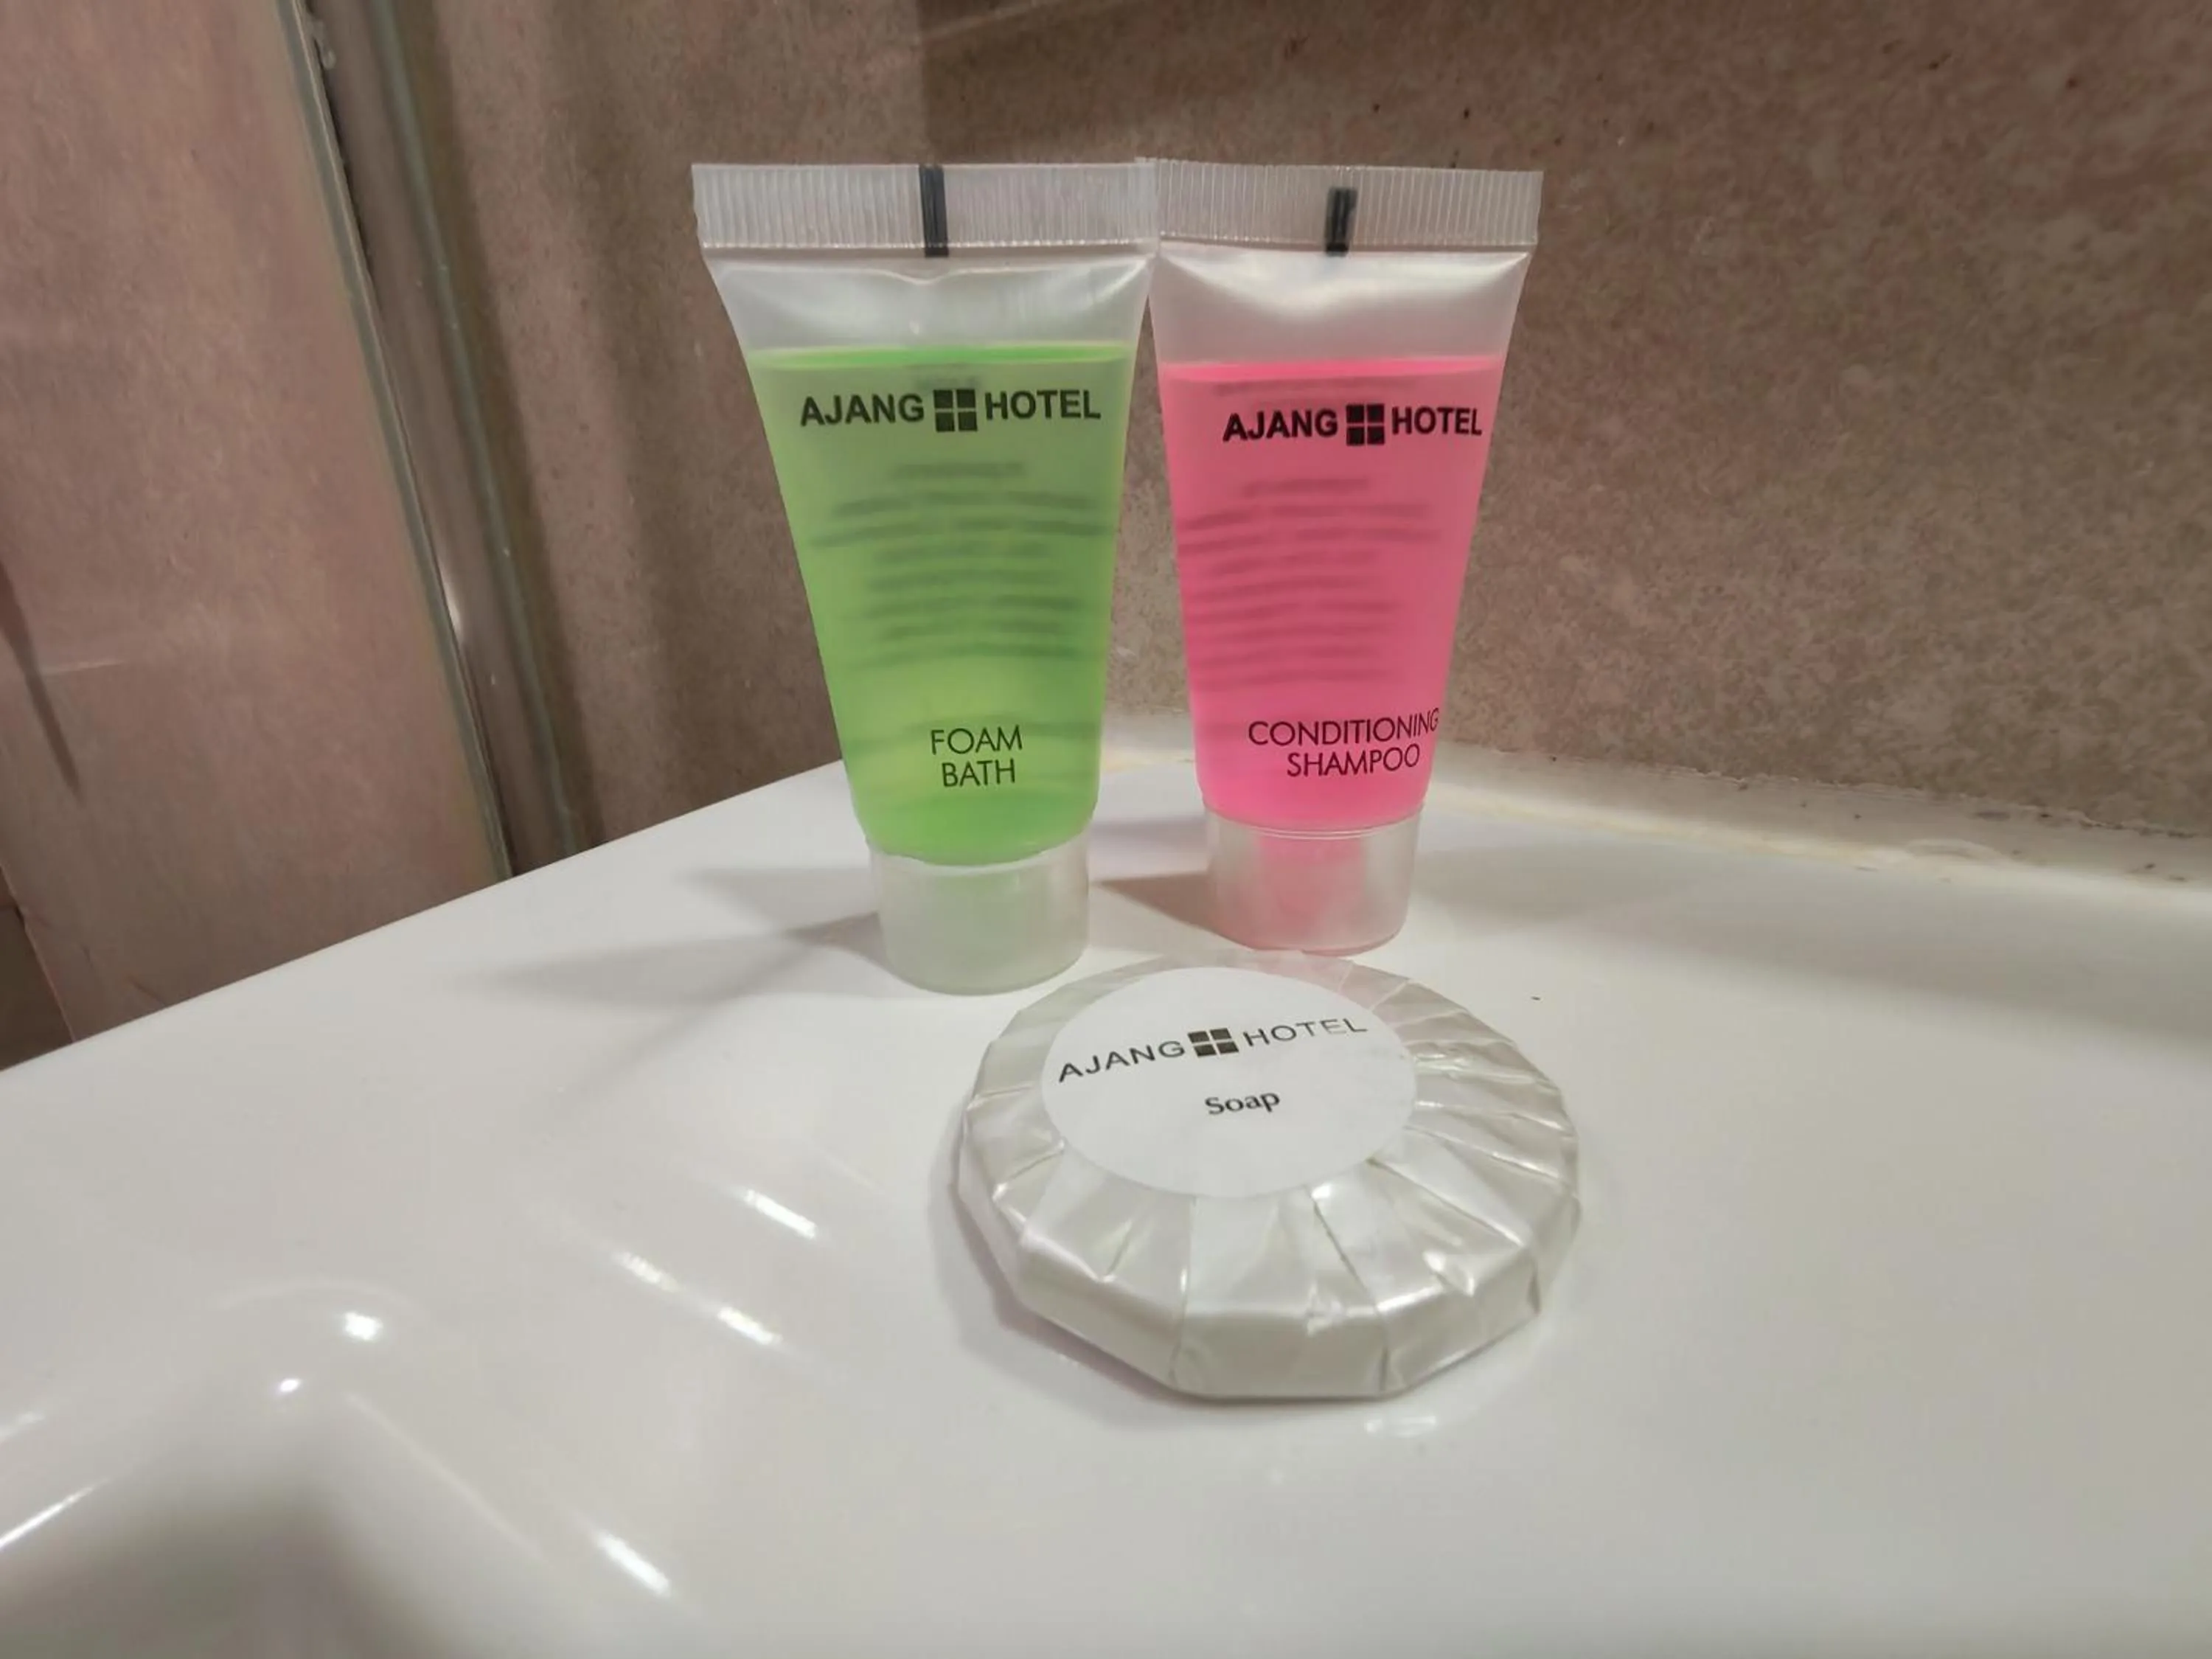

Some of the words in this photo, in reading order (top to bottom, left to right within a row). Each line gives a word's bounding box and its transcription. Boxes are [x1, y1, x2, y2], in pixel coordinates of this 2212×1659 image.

[800, 393, 925, 426] AJANG
[984, 389, 1102, 420] HOTEL
[1222, 408, 1339, 442] AJANG
[1391, 406, 1483, 436] HOTEL
[930, 725, 1023, 755] FOAM
[1248, 707, 1440, 747] CONDITIONING
[941, 758, 1016, 788] BATH
[1286, 742, 1421, 778] SHAMPOO
[1058, 1040, 1186, 1083] AJANG
[1242, 1018, 1368, 1048] HOTEL
[1204, 1091, 1281, 1116] Soap
